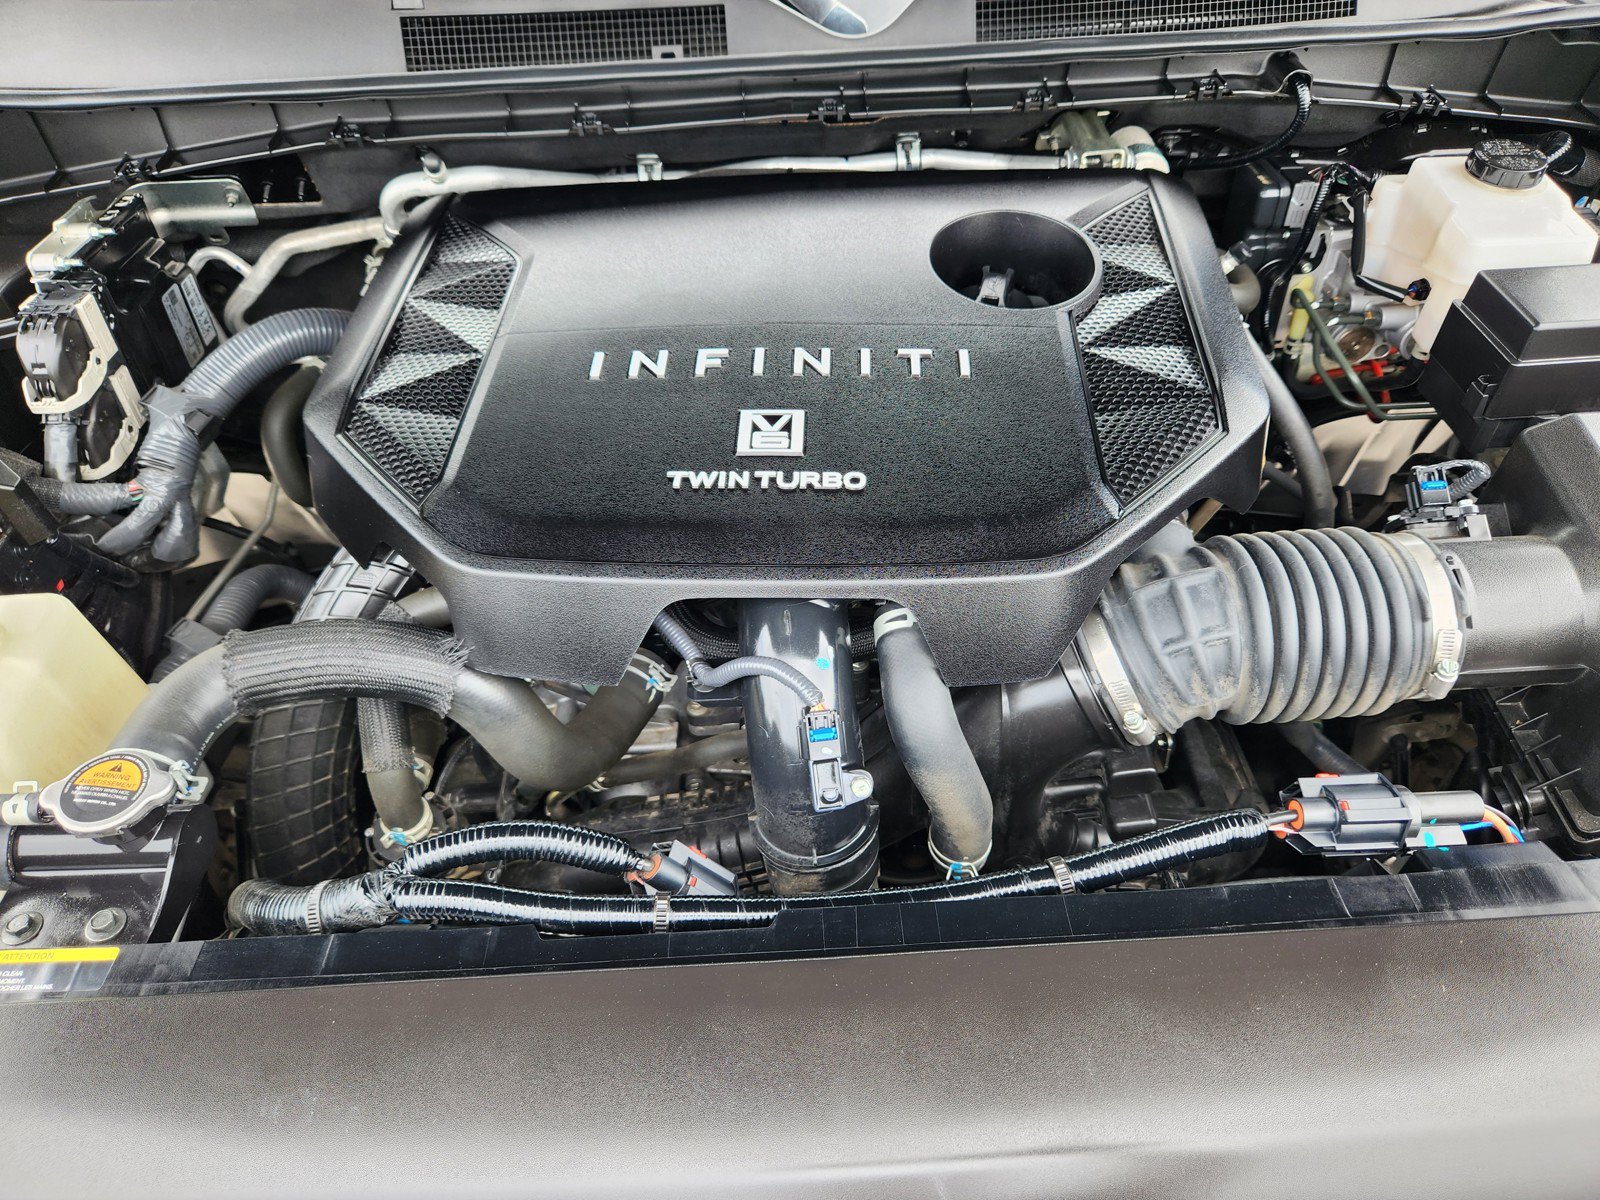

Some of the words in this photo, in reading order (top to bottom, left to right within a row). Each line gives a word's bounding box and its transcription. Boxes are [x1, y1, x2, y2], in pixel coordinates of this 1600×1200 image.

[588, 346, 971, 381] INFINITI
[666, 469, 750, 491] TWIN
[754, 469, 867, 491] TURBO
[93, 771, 131, 781] WARNING
[79, 778, 138, 789] AVERTISSEMENT
[2, 952, 55, 961] ATTENTION
